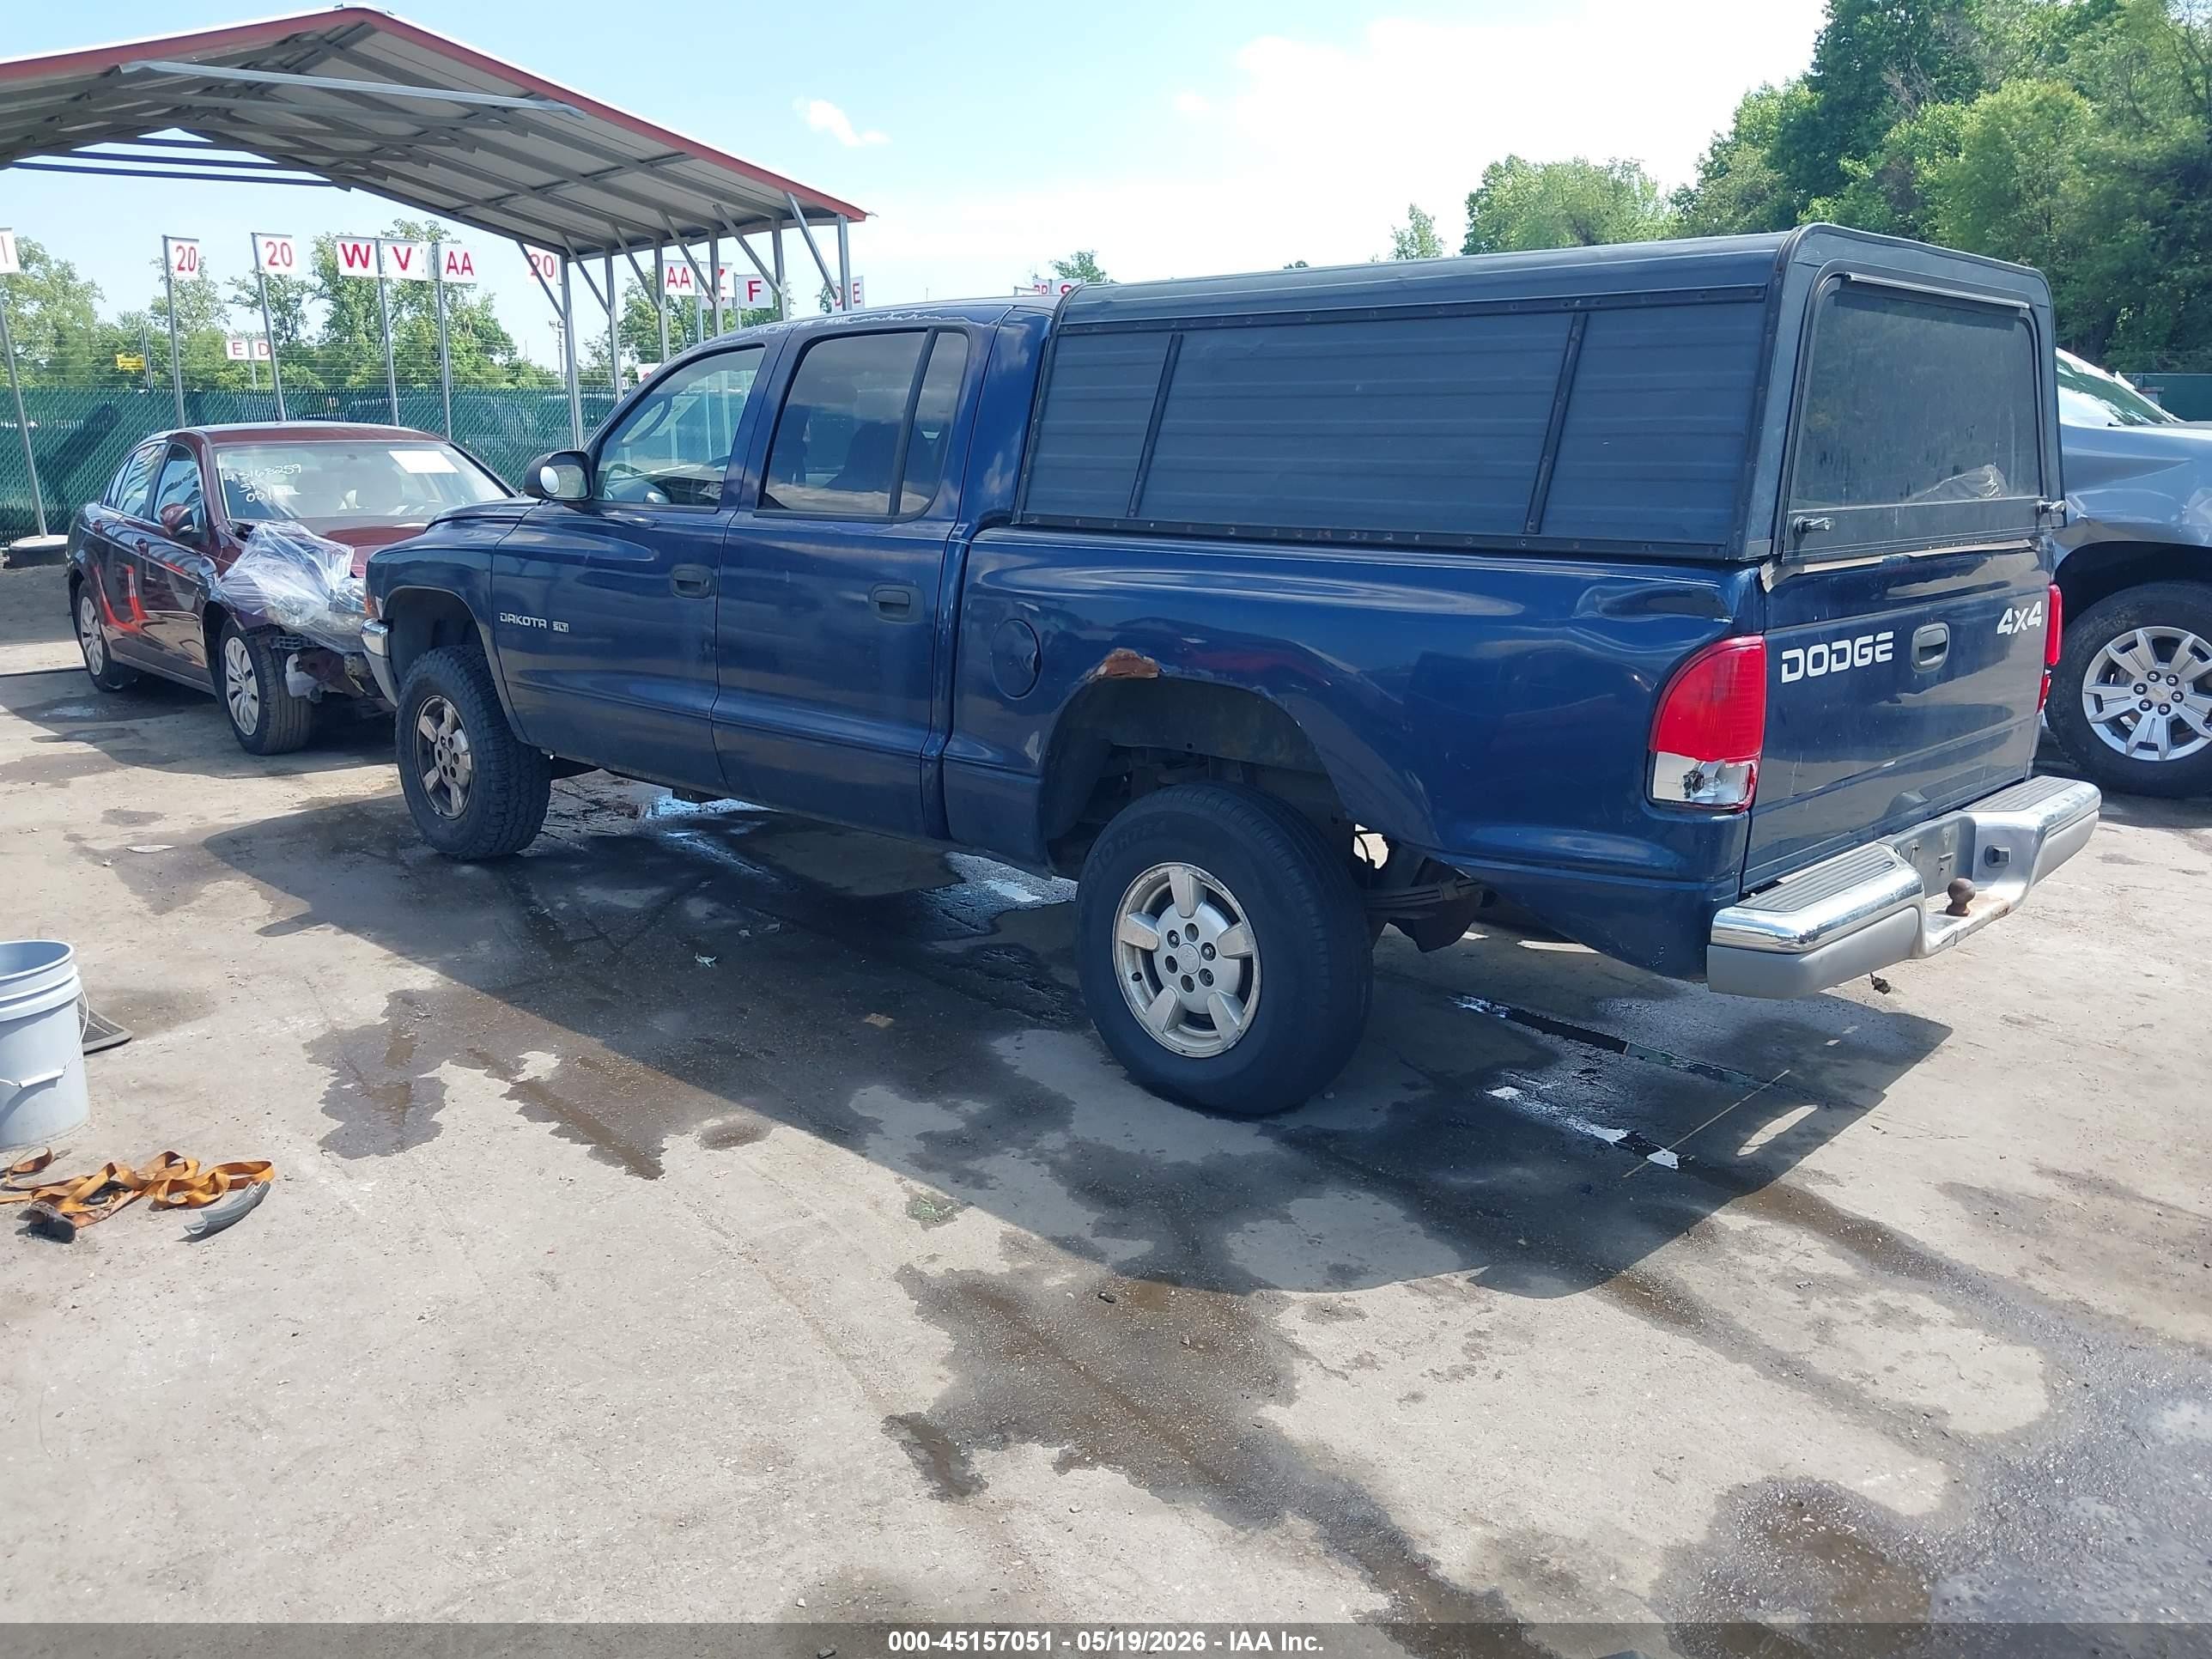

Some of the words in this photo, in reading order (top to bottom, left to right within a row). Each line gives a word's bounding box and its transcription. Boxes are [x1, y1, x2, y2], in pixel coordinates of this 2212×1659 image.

[176, 245, 197, 271] 20
[265, 240, 293, 267] 20
[341, 243, 371, 269] W
[392, 246, 412, 271] V
[446, 251, 475, 276] AA
[529, 253, 555, 278] 20
[666, 266, 691, 289] AA
[747, 280, 762, 302] F
[853, 283, 861, 304] E
[232, 342, 243, 356] E
[258, 343, 270, 356] D
[500, 612, 547, 629] DAKOTA
[1781, 631, 1894, 684] DODGE
